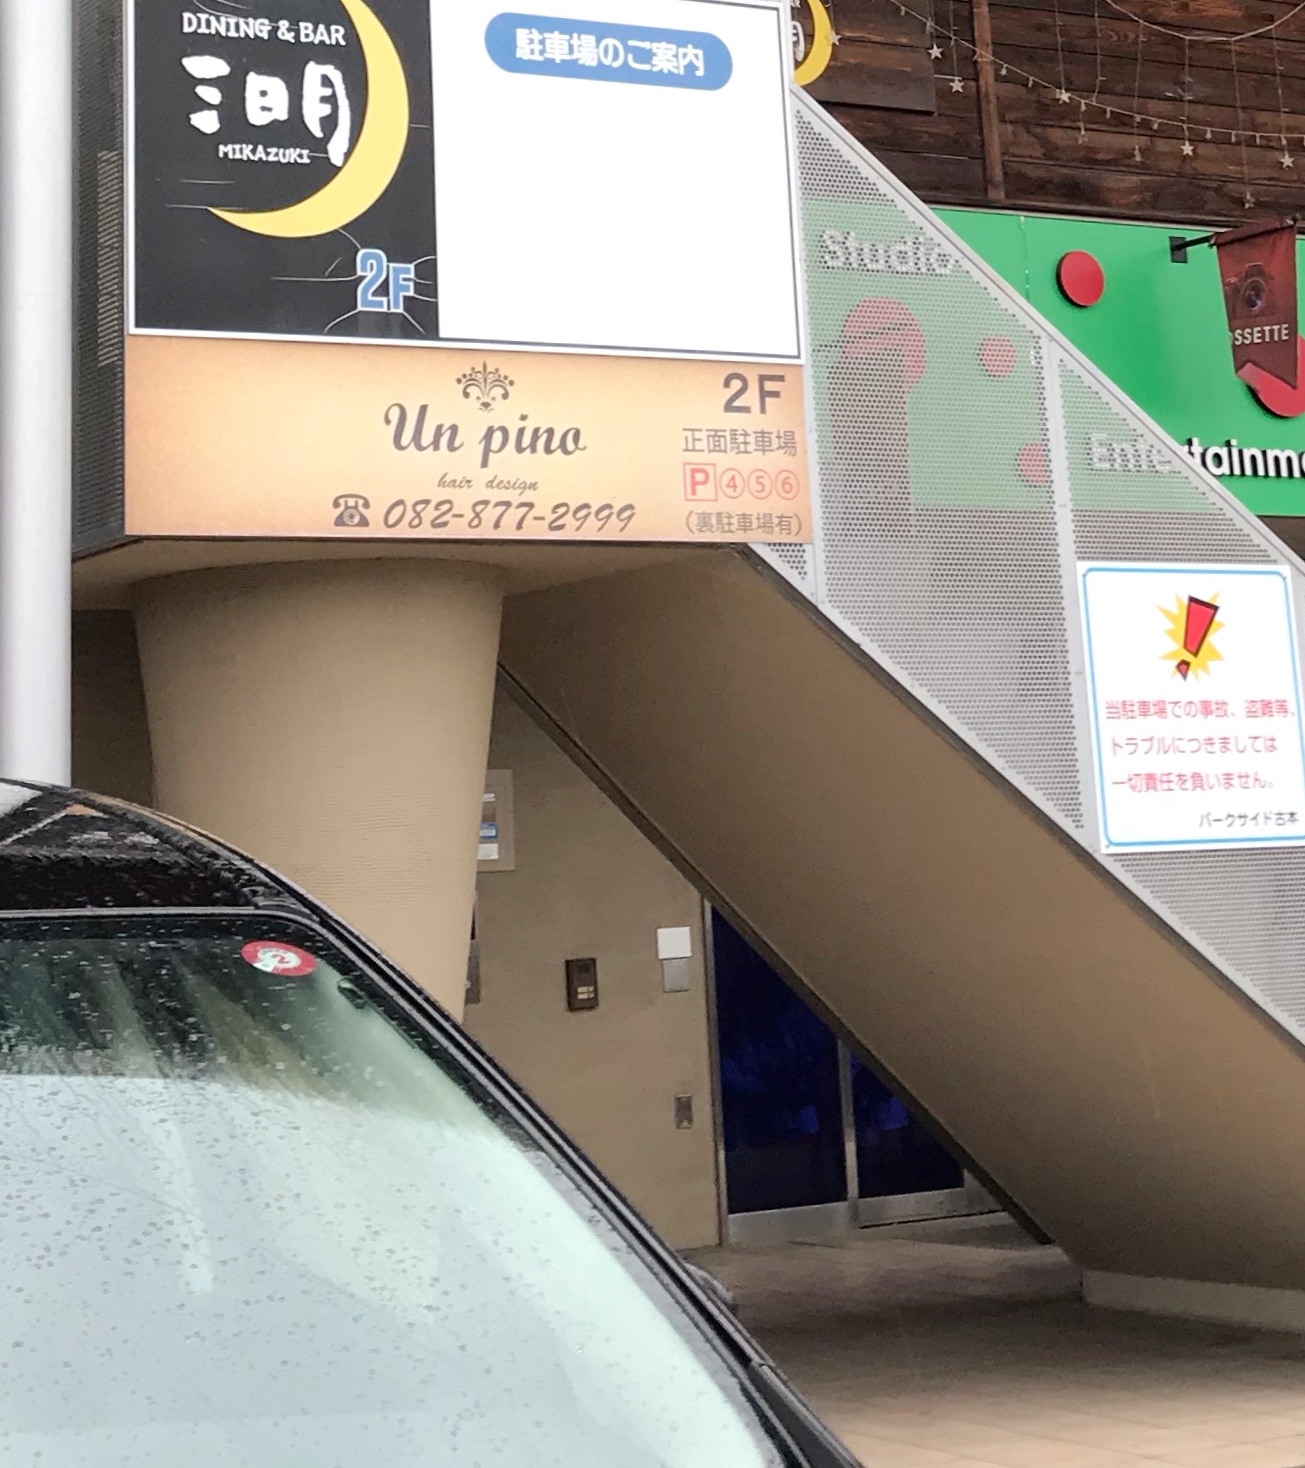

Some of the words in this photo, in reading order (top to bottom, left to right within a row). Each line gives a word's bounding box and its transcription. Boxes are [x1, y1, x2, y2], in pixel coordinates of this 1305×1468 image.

[181, 12, 272, 40] DINING
[276, 19, 296, 44] &
[298, 22, 347, 46] BAR
[515, 27, 705, 77] 駐車場のご案内
[181, 54, 352, 168] 三日月
[218, 143, 312, 164] MIKAZUKI
[356, 248, 416, 312] 2F
[1233, 323, 1290, 346] SSETTE
[722, 371, 786, 415] 2F
[383, 401, 464, 453] Un
[478, 412, 588, 469] pino
[682, 427, 798, 458] 正面駐車場
[436, 471, 475, 491] hair
[484, 474, 540, 497] design
[383, 498, 637, 534] 082-877-2999
[1111, 735, 1279, 756] トラブルにつきましては
[1111, 771, 1275, 793] 一切責任を負いません。
